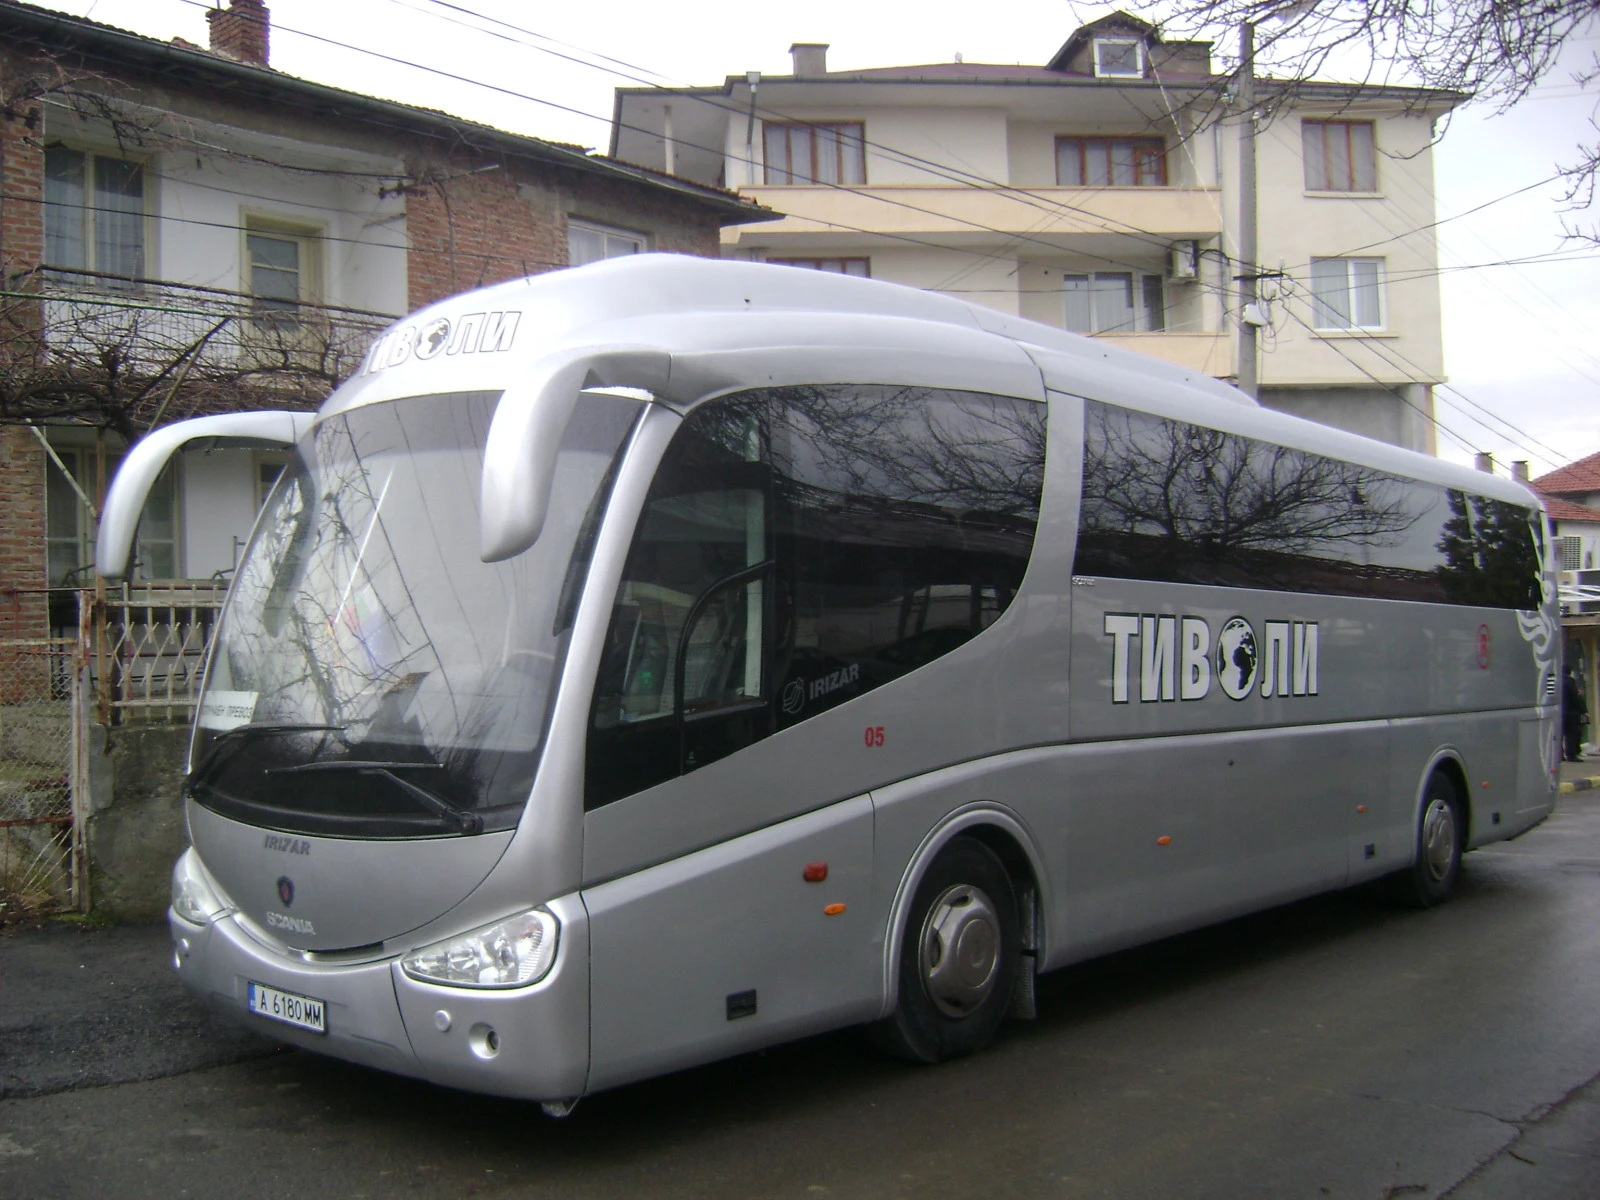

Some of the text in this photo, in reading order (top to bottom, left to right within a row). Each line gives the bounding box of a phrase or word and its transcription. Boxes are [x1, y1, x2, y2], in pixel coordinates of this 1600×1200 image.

[1104, 611, 1319, 704] ТИВОЛИ
[809, 663, 860, 699] IRIZAR
[864, 726, 885, 748] 05
[264, 834, 311, 855] IRIZAR
[266, 911, 316, 935] SCANIA
[273, 994, 302, 1020] 6180
